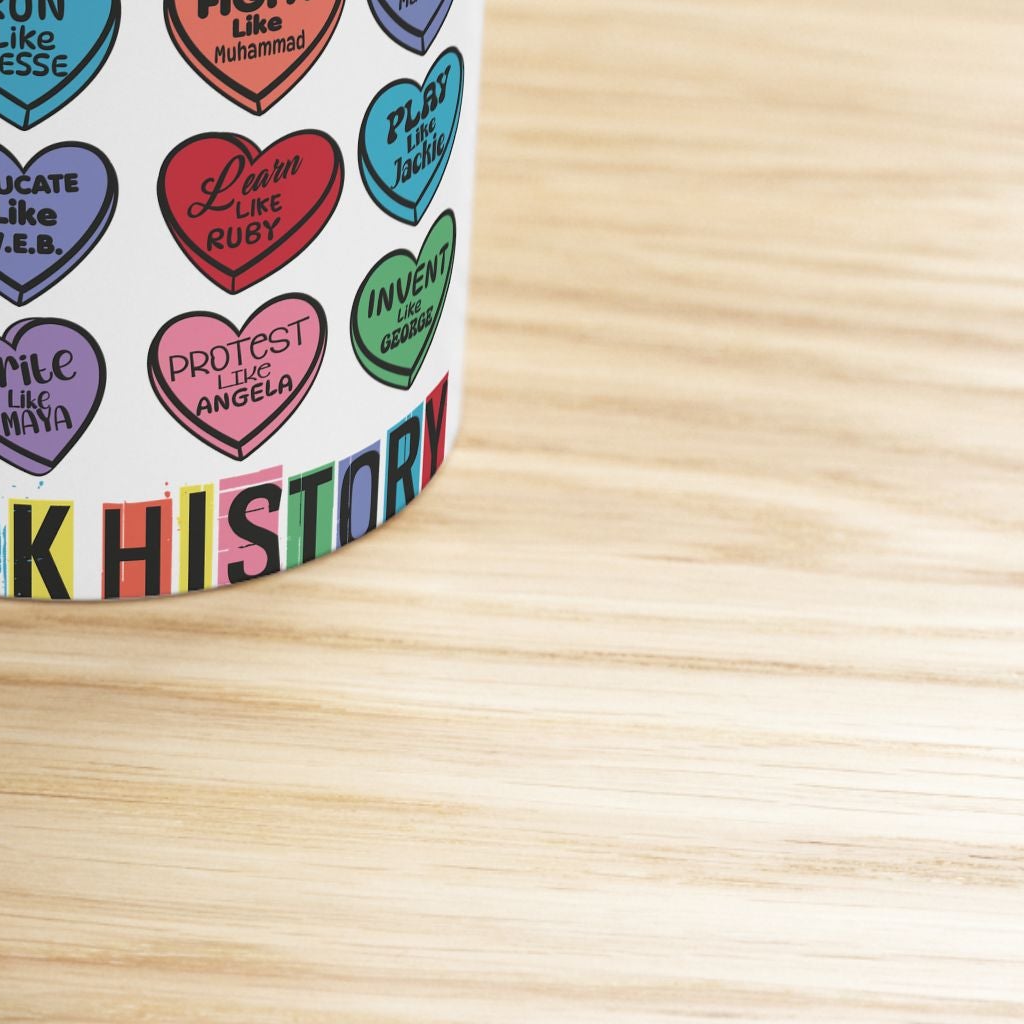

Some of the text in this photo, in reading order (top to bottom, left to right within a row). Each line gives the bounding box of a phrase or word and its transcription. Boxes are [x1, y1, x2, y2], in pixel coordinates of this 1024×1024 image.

[232, 14, 283, 38] Like
[215, 29, 306, 64] Muhammad
[386, 64, 452, 144] PLAY
[406, 118, 436, 153] Like
[390, 134, 446, 189] Jackie
[187, 154, 304, 219] Learn
[236, 195, 282, 219] LIKE
[207, 217, 281, 251] RUBY
[367, 243, 450, 319] INVENT
[397, 298, 422, 324] Like
[380, 306, 433, 353] GEORGE
[8, 390, 51, 410] Like
[196, 374, 294, 416] ANGELA
[1, 405, 73, 437] MAYA
[103, 379, 449, 599] HISTORY
